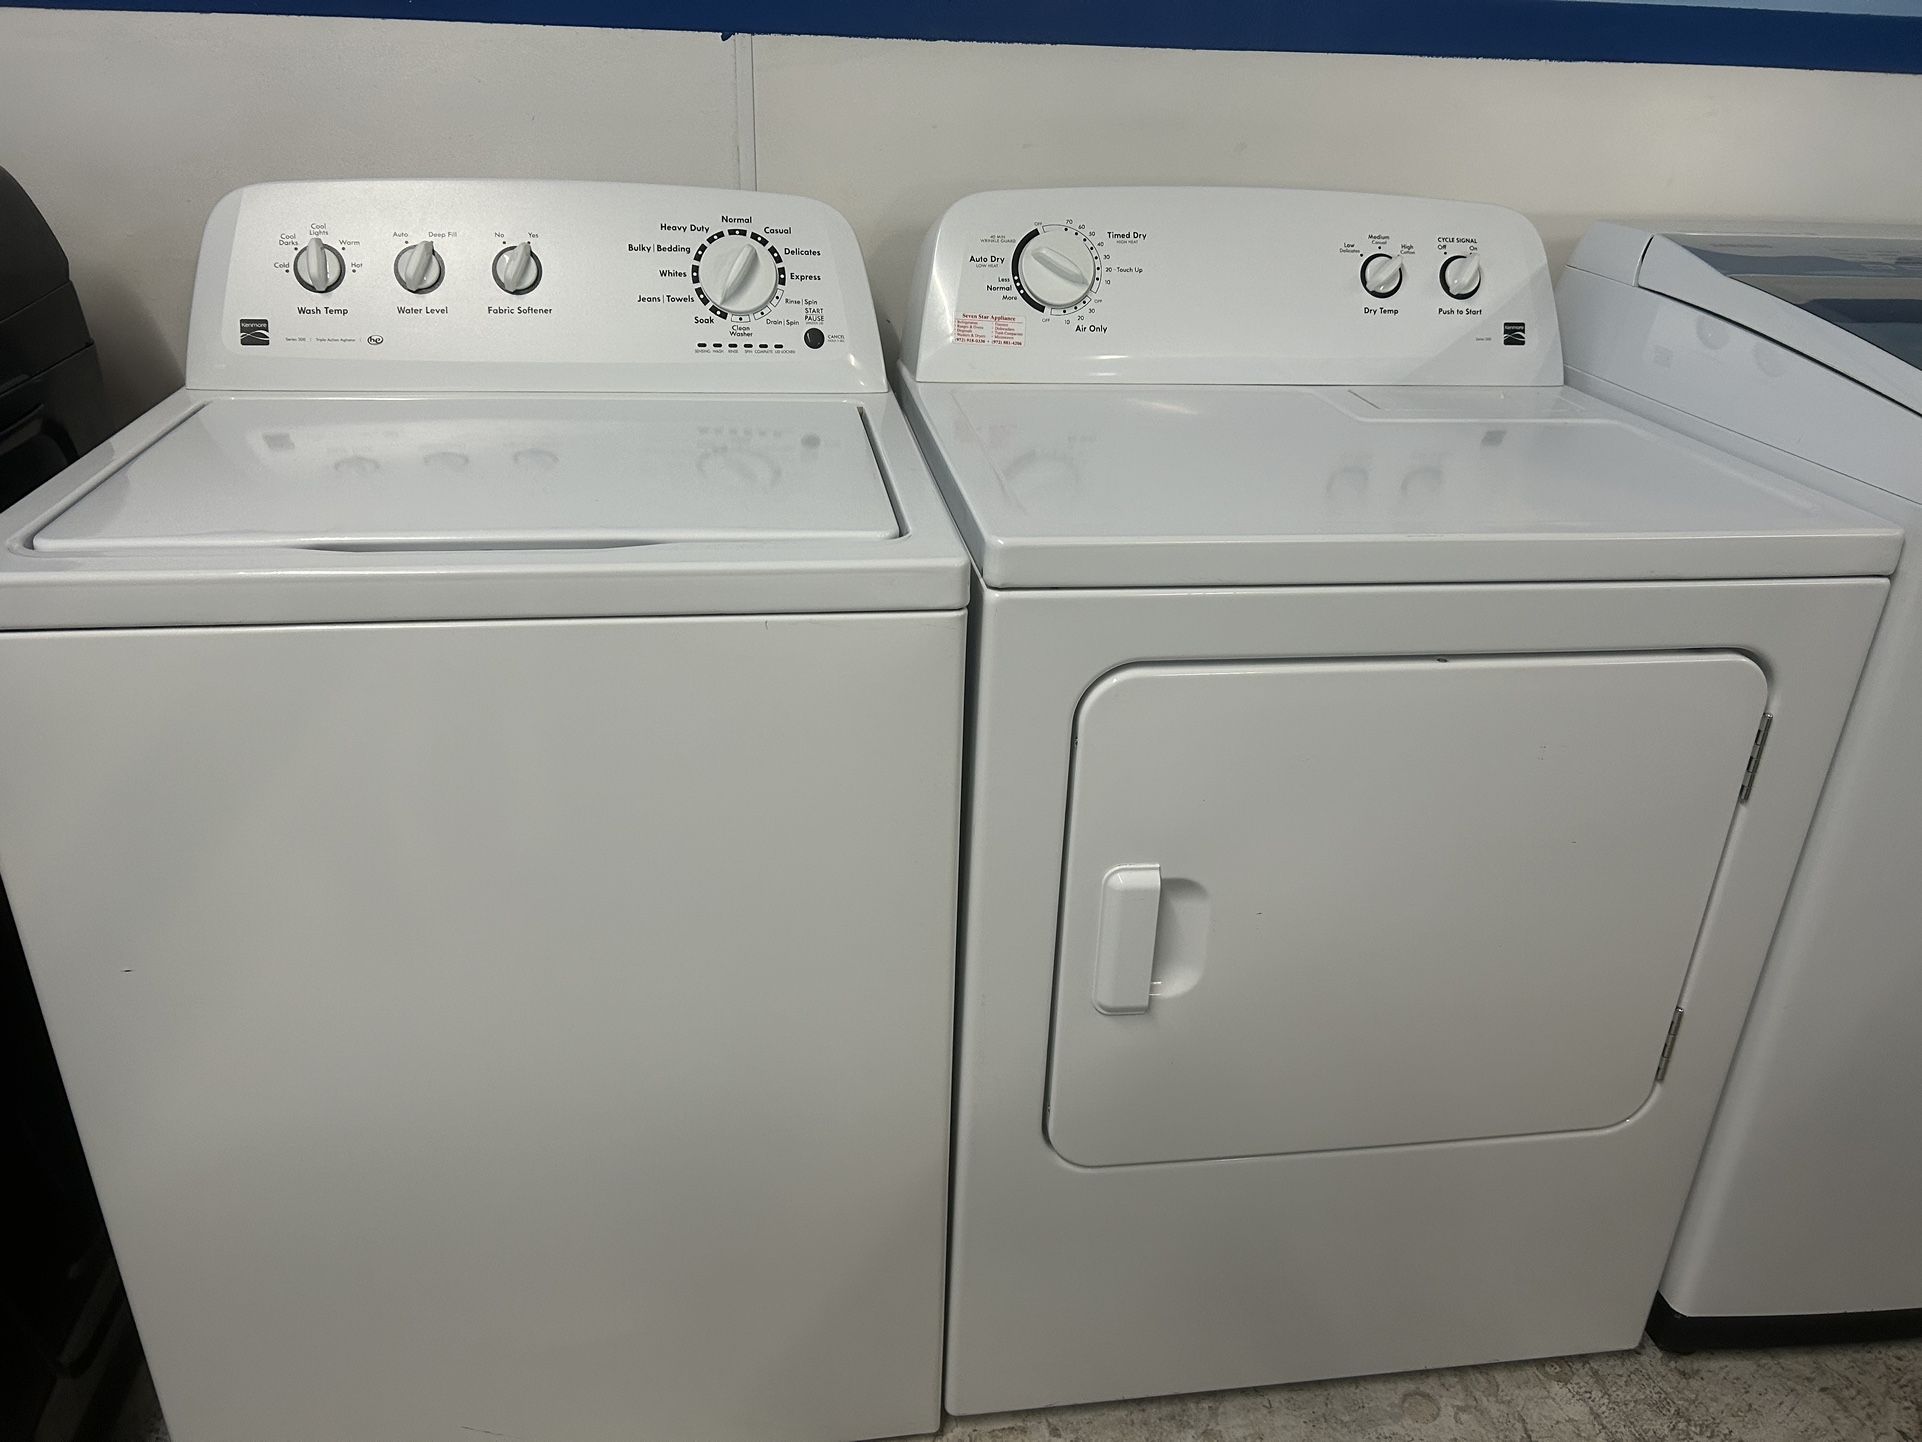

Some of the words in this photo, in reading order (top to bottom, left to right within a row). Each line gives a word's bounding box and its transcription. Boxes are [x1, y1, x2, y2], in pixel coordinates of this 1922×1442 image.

[661, 224, 688, 233] Heavy
[690, 225, 709, 233] Duty
[428, 231, 446, 239] Deep
[1133, 232, 1146, 241] Dry
[629, 244, 651, 253] Bulky
[657, 245, 690, 254] Bedding
[991, 256, 1005, 264] Dry
[790, 273, 821, 282] Express
[298, 306, 321, 315] Wash
[323, 306, 348, 317] Temp
[397, 306, 422, 315] Water
[425, 306, 448, 315] Level
[488, 306, 514, 315] Fabric
[518, 306, 552, 315] Softener
[1364, 307, 1377, 315] Dry
[1090, 325, 1107, 334] Only
